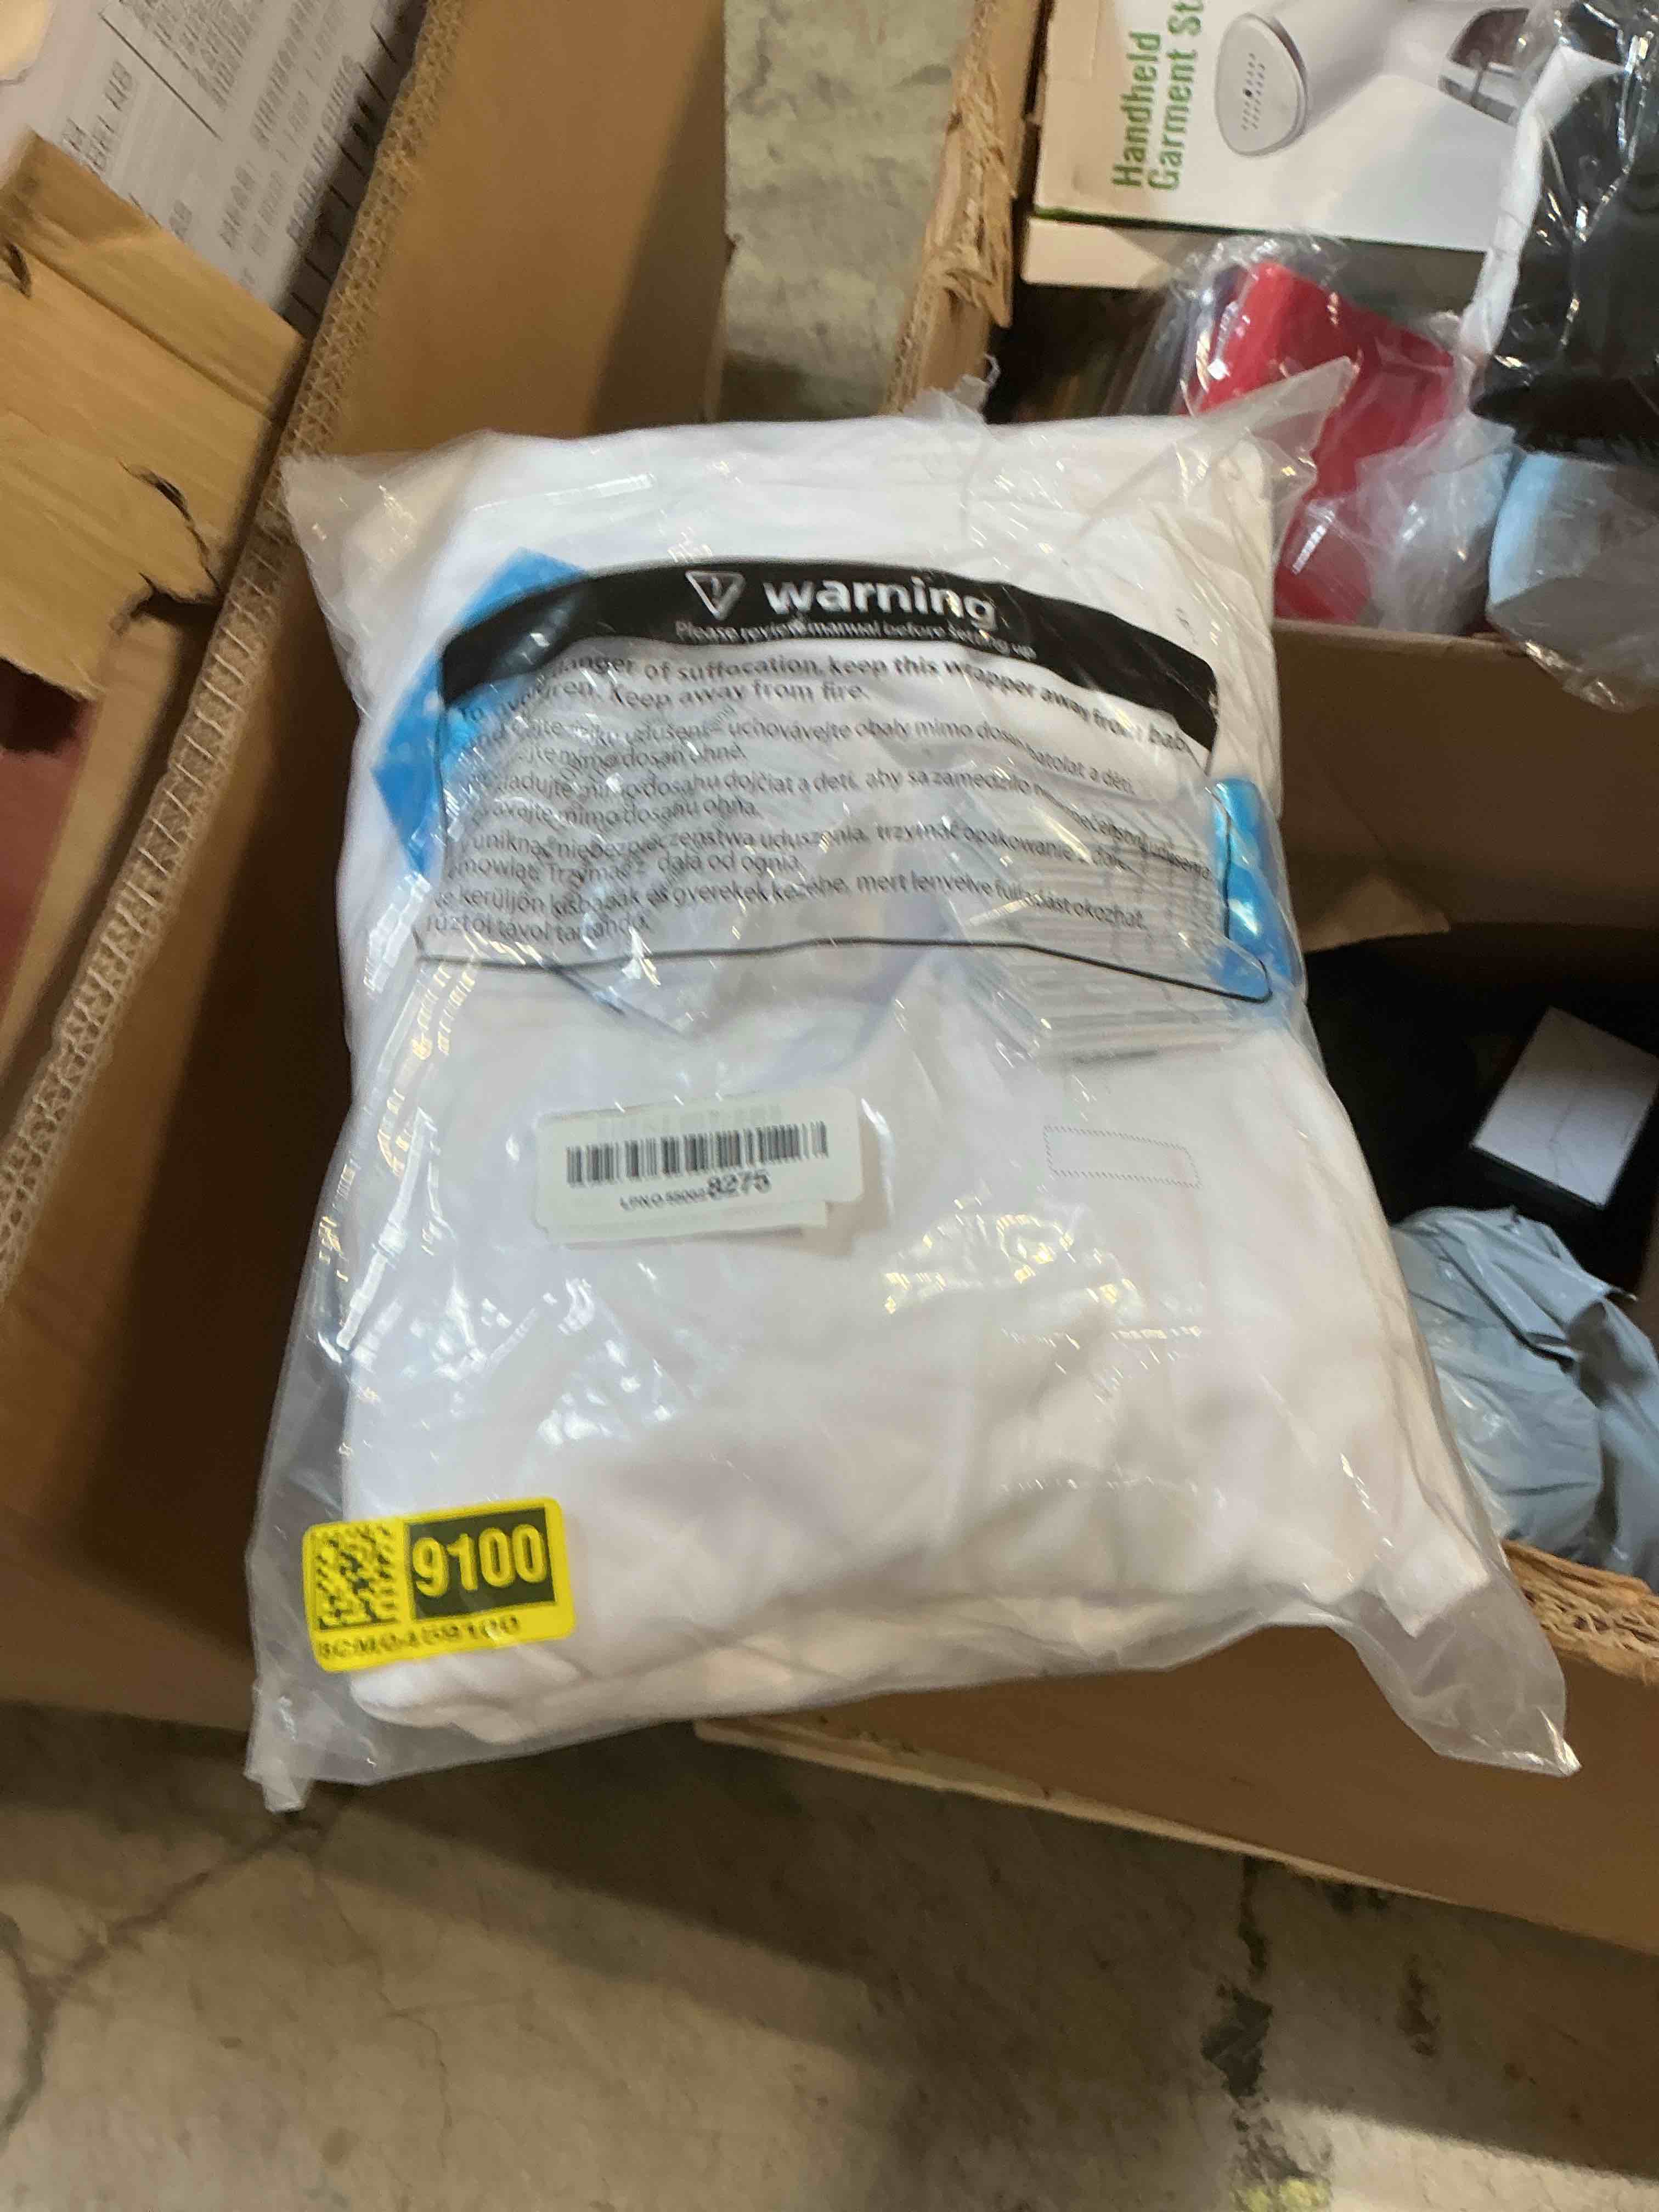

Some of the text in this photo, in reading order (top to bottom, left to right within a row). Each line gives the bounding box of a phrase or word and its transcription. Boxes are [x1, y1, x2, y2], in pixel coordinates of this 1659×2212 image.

[1111, 30, 1161, 188] Handheld
[1147, 49, 1198, 190] Garment
[763, 575, 998, 632] warning
[675, 620, 739, 644] Please
[807, 619, 879, 638] manual
[644, 660, 672, 682] of
[827, 655, 889, 680] keep
[893, 654, 938, 676] this
[753, 679, 815, 703] from
[865, 768, 905, 793] aby
[907, 769, 930, 786] sa
[707, 849, 737, 873] od
[412, 1524, 549, 1598] 9100
